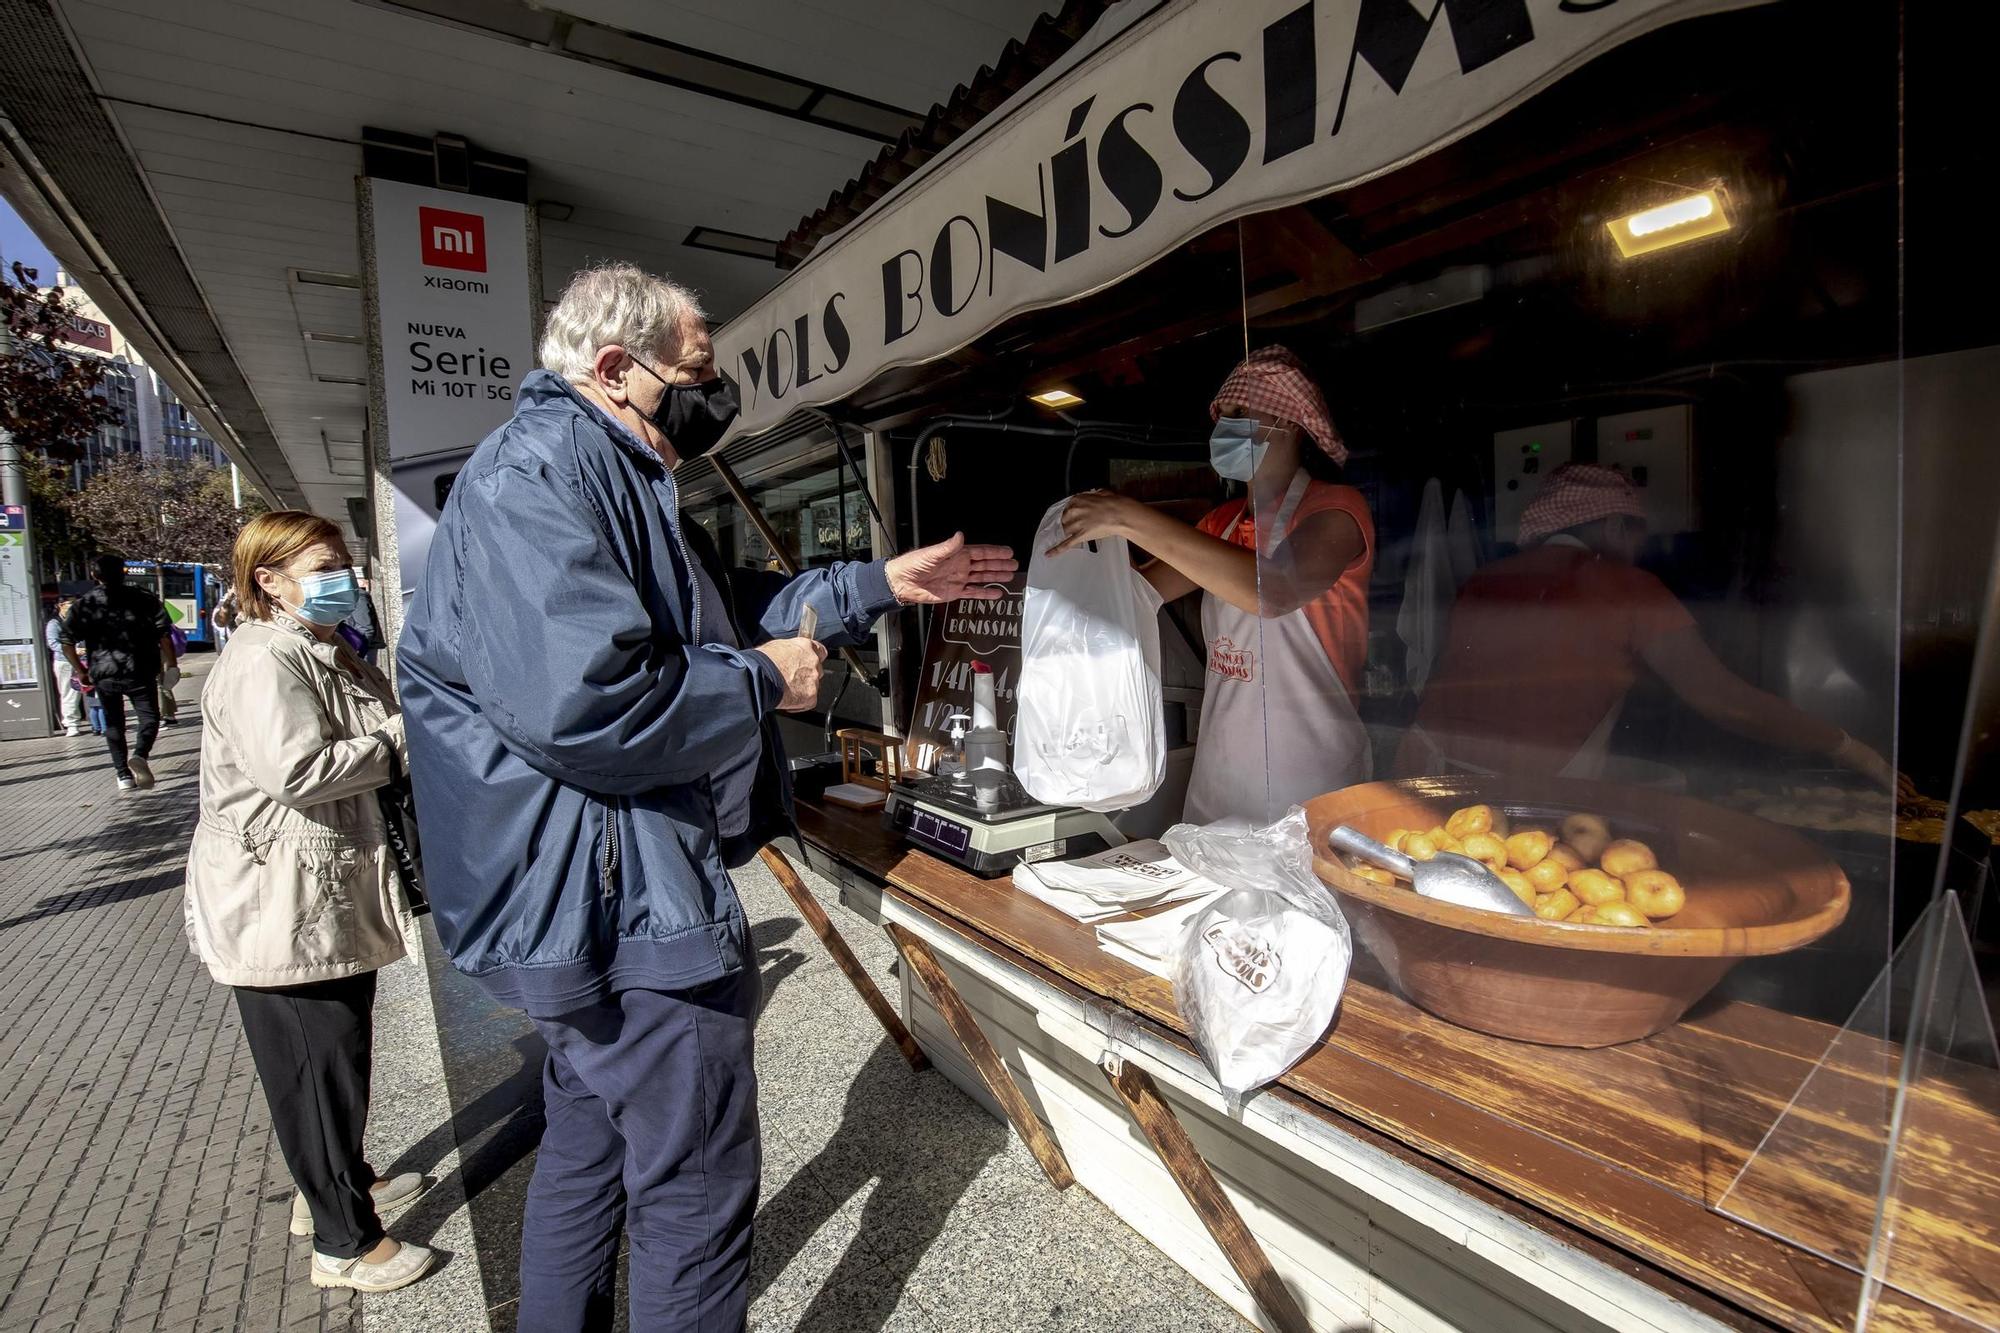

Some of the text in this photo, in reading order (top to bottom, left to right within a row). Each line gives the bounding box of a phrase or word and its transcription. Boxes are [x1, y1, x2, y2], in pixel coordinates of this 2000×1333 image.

[881, 0, 1618, 346] BONÍSSIM
[408, 322, 466, 340] NUEVA
[409, 341, 511, 380] Serie
[411, 379, 435, 396] Mi
[948, 618, 1022, 637] BONISSIM
